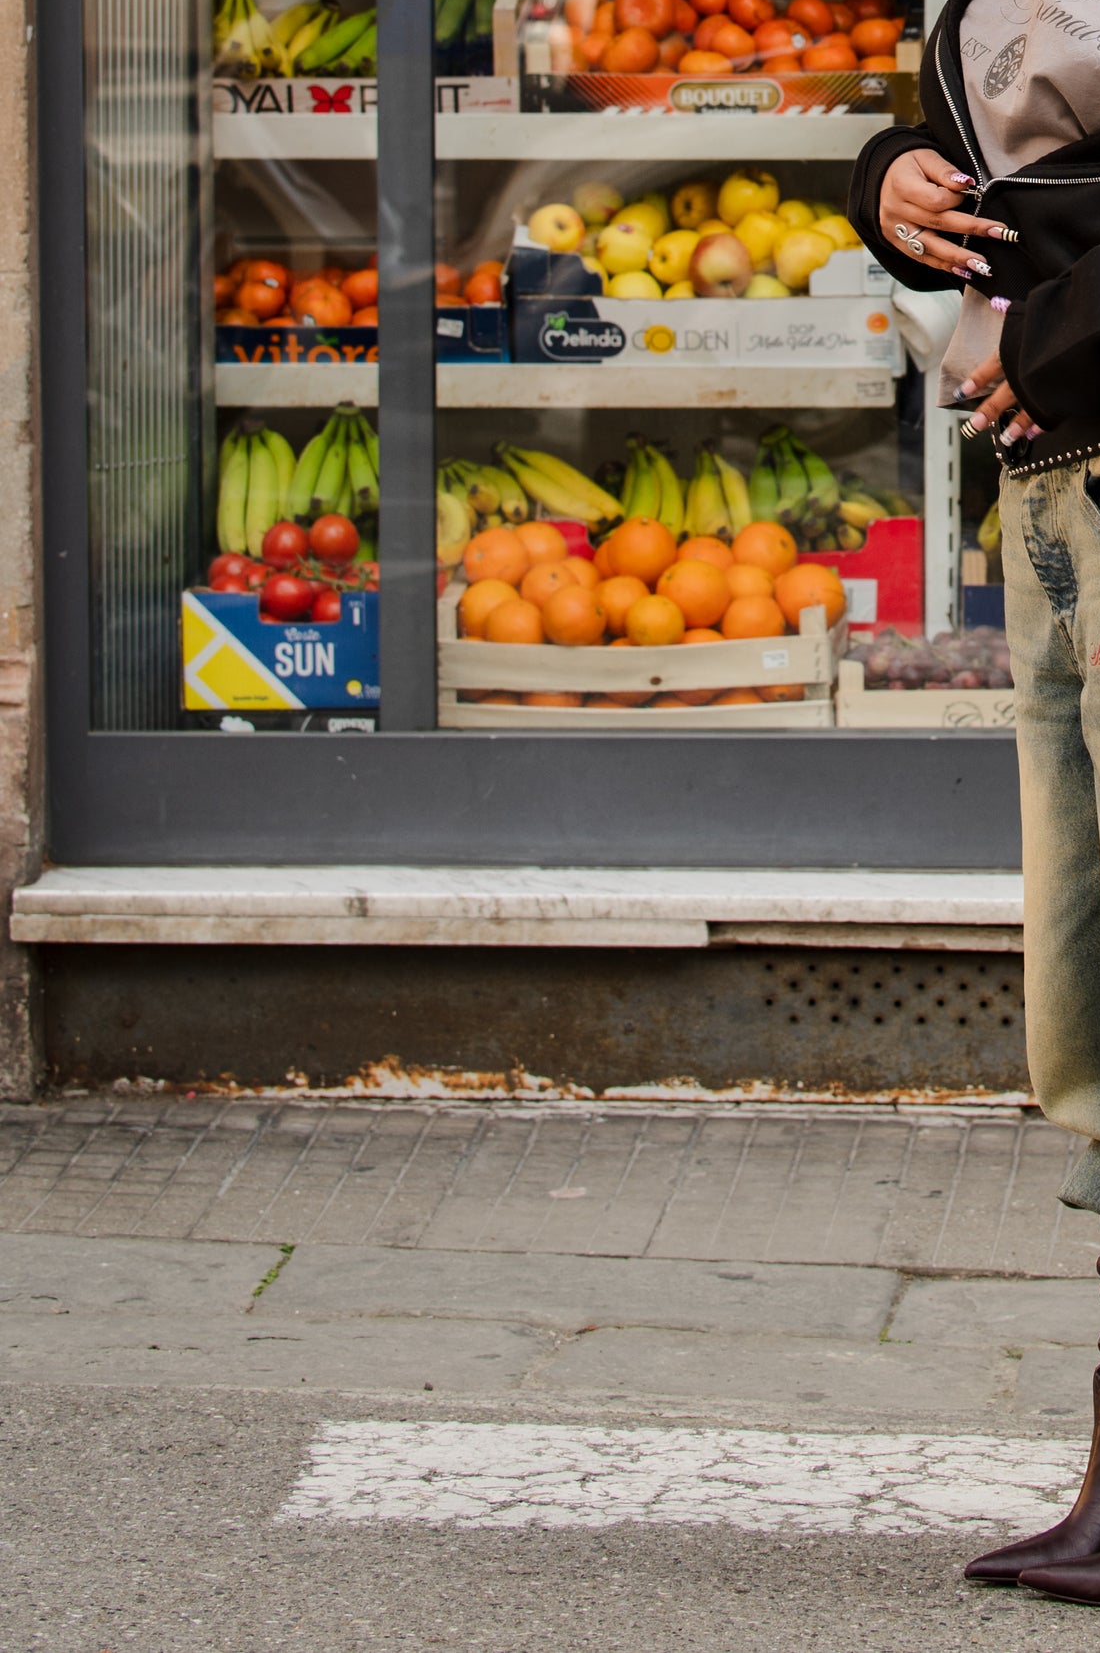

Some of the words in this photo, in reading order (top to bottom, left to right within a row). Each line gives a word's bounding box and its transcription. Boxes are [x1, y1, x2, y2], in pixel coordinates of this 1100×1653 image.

[960, 37, 992, 62] EST
[681, 89, 772, 106] BOUQUET
[544, 326, 623, 349] Melinda
[632, 325, 729, 354] GOLDEN
[274, 642, 335, 677] SUN
